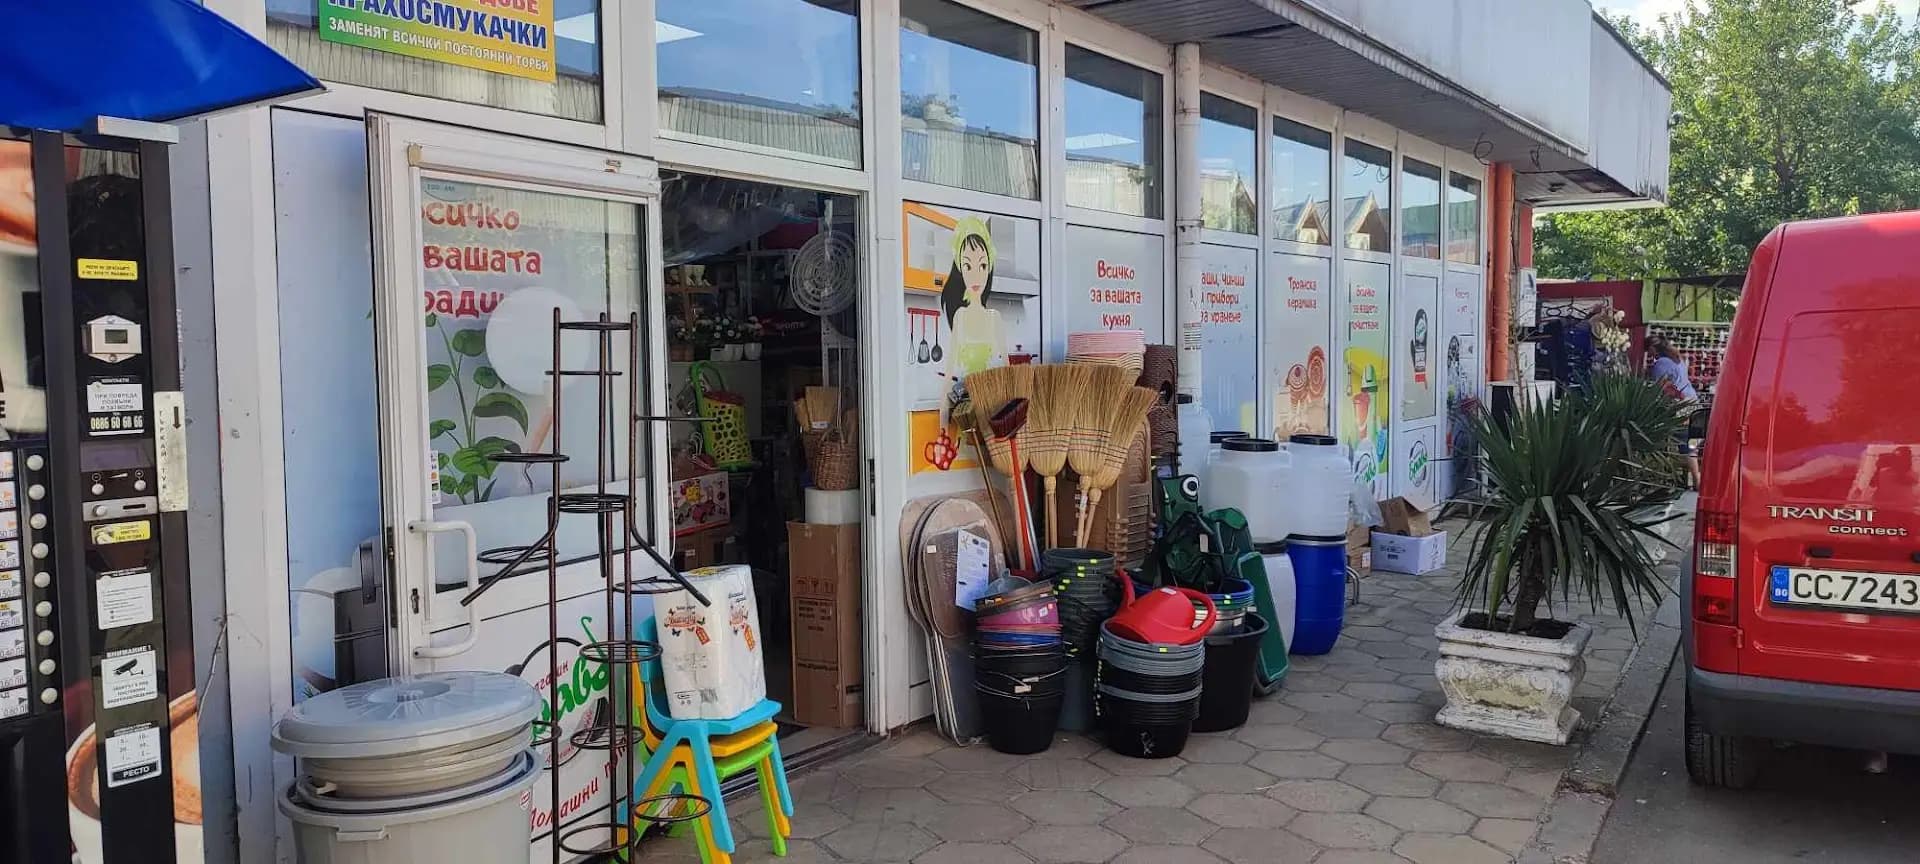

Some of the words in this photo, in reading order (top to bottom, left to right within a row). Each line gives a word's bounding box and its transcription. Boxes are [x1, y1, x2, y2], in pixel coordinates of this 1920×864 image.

[328, 0, 546, 49] АХОСМУКАЧКИ
[329, 16, 389, 40] ЗАМЕНЯТ
[393, 30, 441, 50] ВСИЧКИ
[445, 41, 514, 65] ПОСТОЯННИ
[516, 55, 549, 72] ТОРБИ
[421, 202, 520, 231] сичко
[423, 245, 541, 275] вашата
[1097, 260, 1135, 280] Всичко
[1090, 289, 1102, 303] за
[1104, 289, 1142, 304] вашата
[1206, 291, 1240, 309] прибори
[1102, 313, 1131, 330] кухня
[1210, 311, 1242, 326] хранене
[1767, 505, 1877, 523] TRANSIT
[1829, 525, 1908, 537] connect
[1775, 588, 1788, 597] BG
[1841, 576, 1919, 606] 7243
[123, 765, 151, 779] РЕСТО
